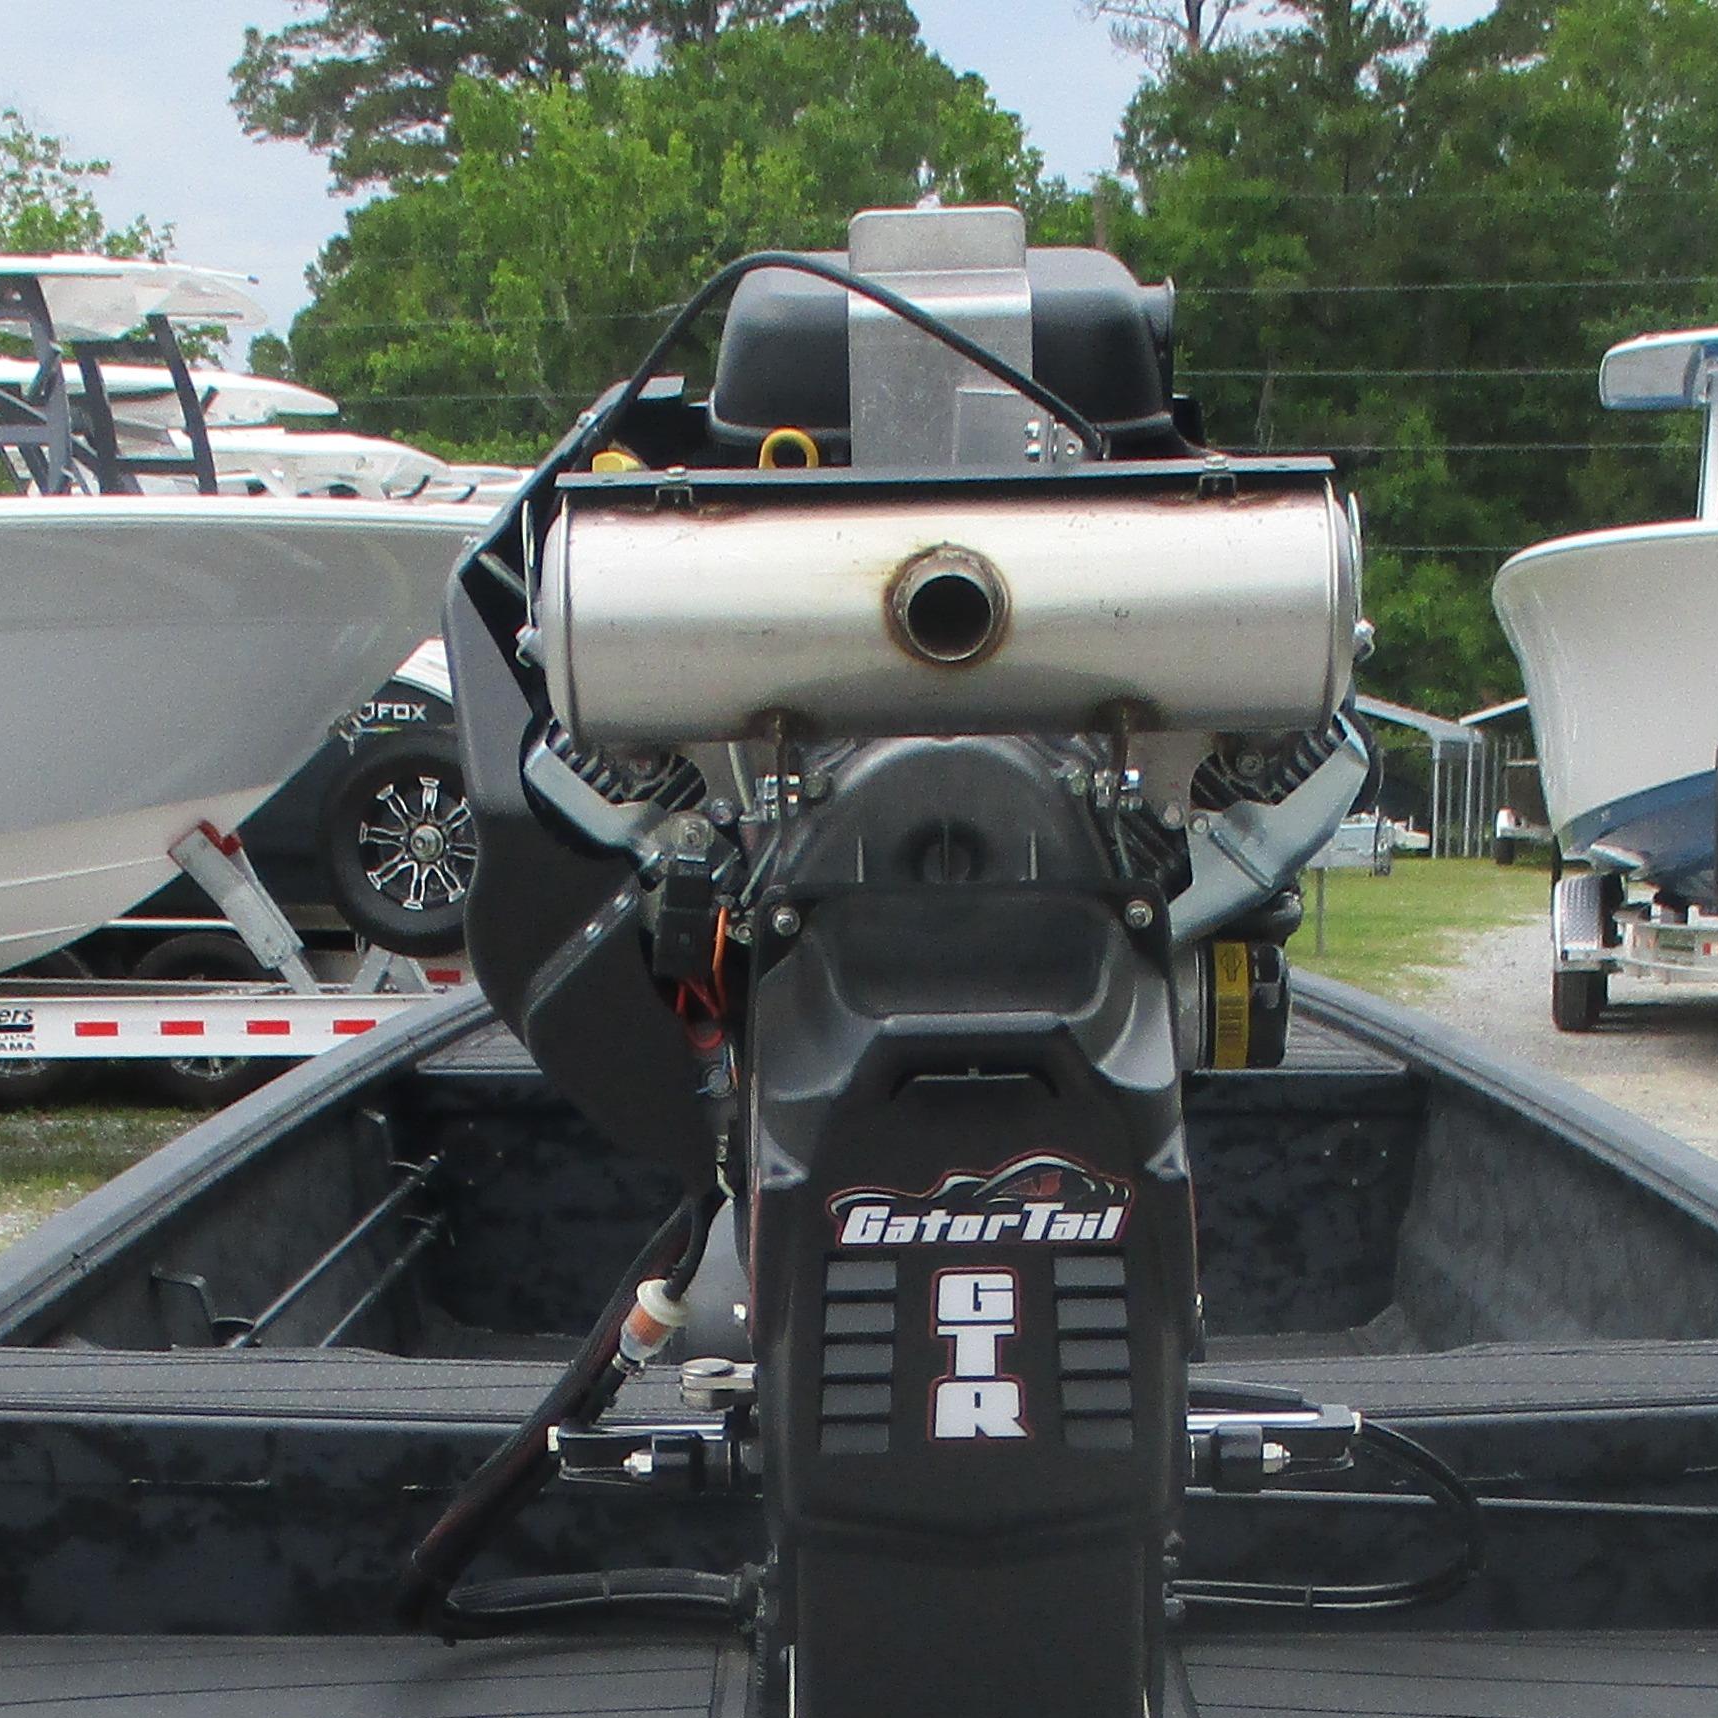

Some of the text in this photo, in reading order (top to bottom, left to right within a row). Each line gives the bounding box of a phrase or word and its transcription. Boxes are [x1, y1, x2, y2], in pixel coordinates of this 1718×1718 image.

[377, 702, 428, 721] FOX
[840, 1203, 1127, 1244] GatorTail
[934, 1273, 1029, 1438] GTR
